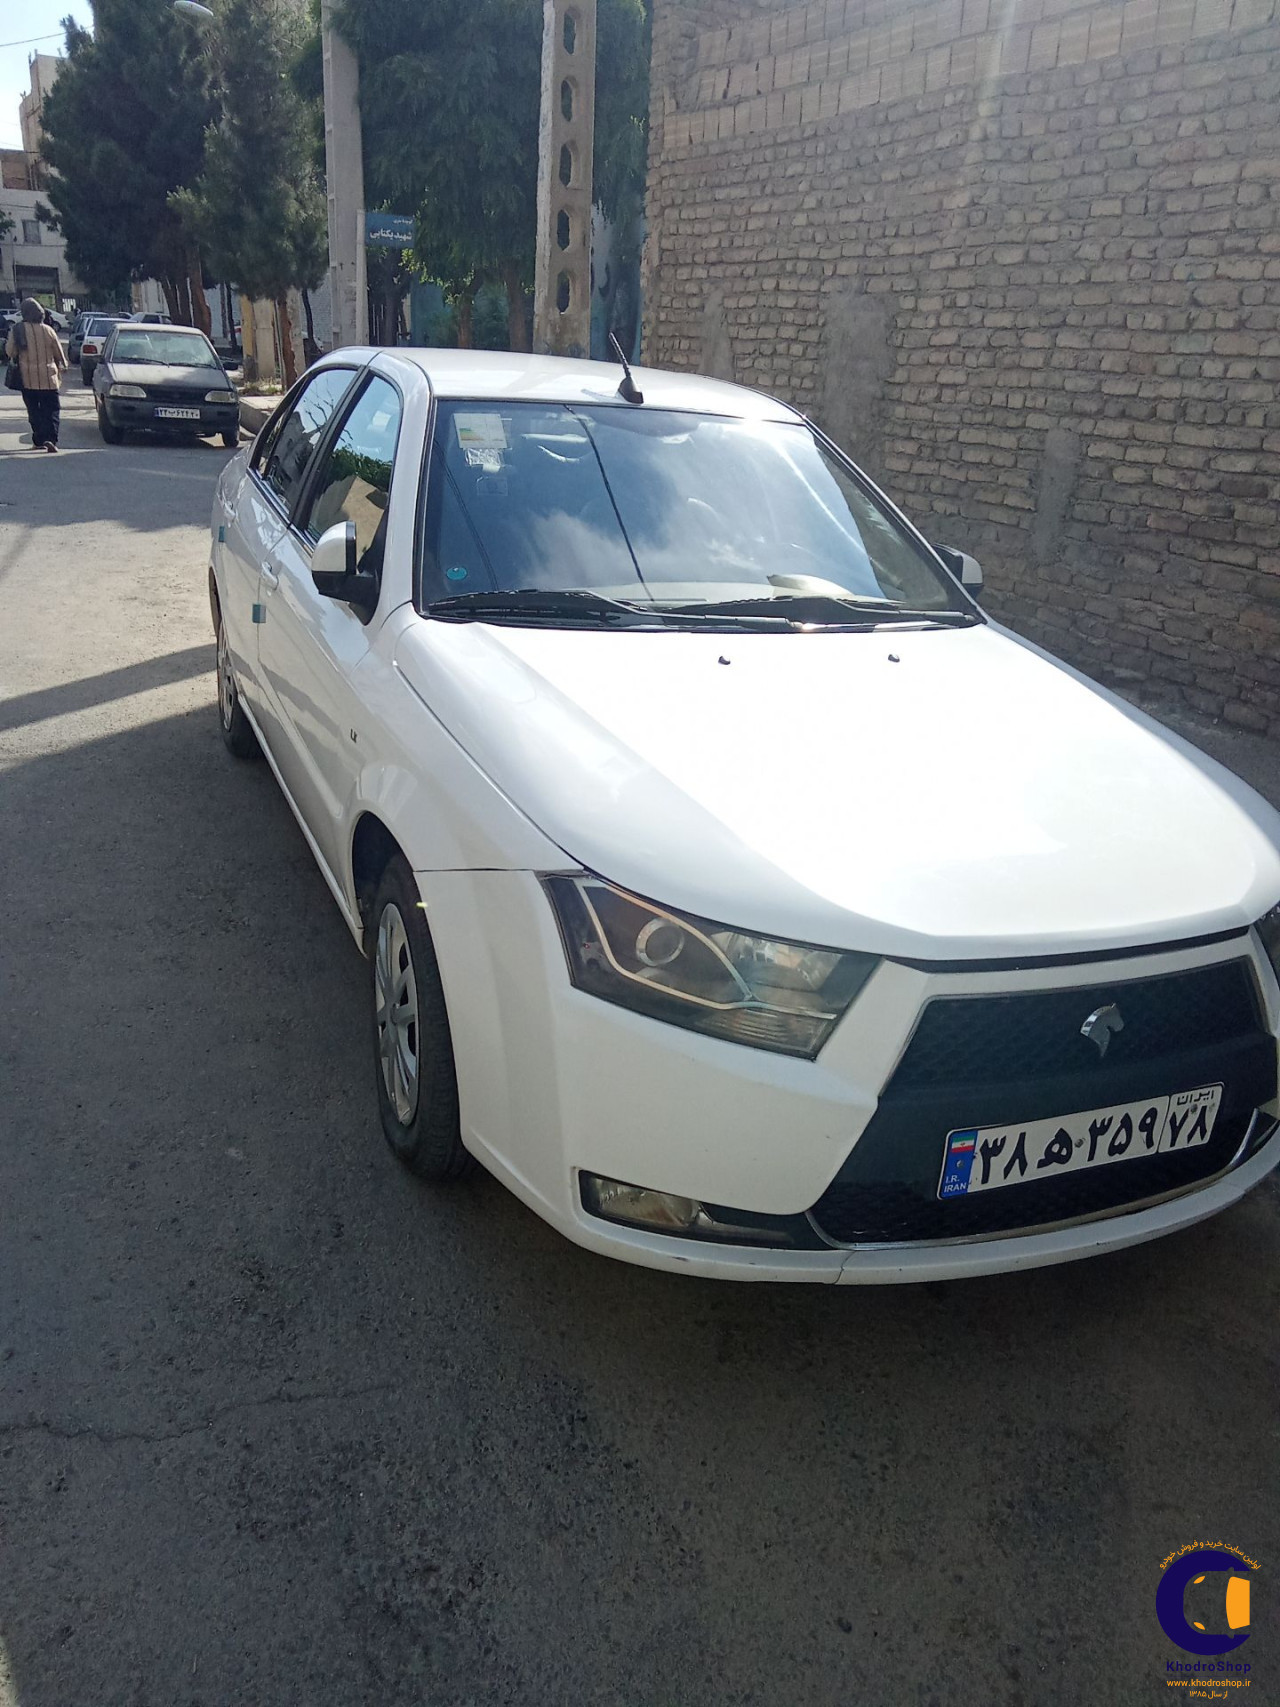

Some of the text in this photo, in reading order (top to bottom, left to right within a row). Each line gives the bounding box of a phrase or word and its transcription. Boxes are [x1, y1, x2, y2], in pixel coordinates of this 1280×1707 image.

[393, 231, 413, 241] شهید
[1177, 1089, 1215, 1106] ایران
[943, 1182, 967, 1193] IRAN
